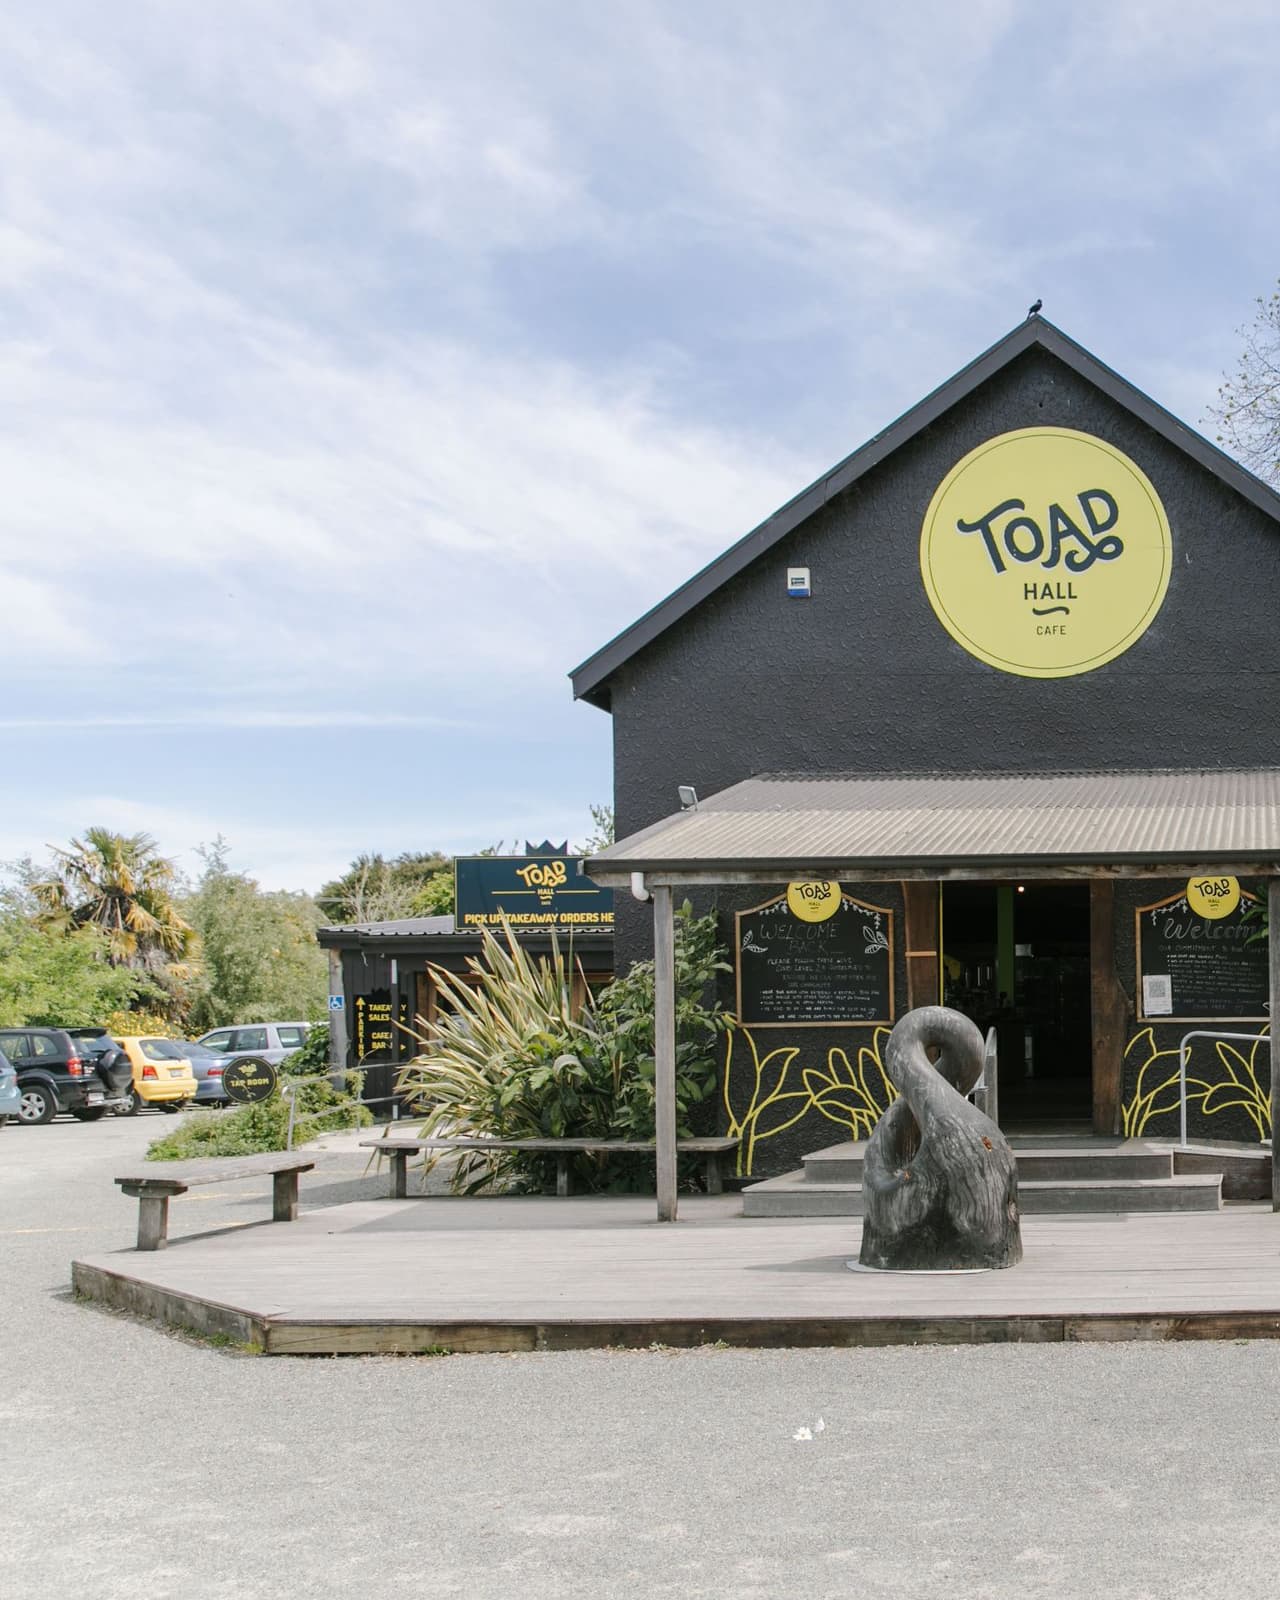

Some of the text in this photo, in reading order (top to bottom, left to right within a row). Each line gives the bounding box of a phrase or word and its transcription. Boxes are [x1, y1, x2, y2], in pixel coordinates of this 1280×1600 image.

[957, 488, 1124, 574] TOAD
[1024, 582, 1078, 600] HALL
[1036, 625, 1067, 636] CAFE
[516, 861, 567, 888] TOAD
[537, 888, 555, 896] HALL
[795, 881, 832, 900] TOAD
[1194, 878, 1231, 898] TOAD
[464, 913, 488, 924] PICK
[489, 913, 503, 924] UP
[505, 912, 559, 924] TAKEAWAY
[560, 912, 599, 923] ORDERS
[760, 923, 840, 940] WELCOME
[1164, 917, 1257, 940] Welcom
[368, 1004, 407, 1012] TAKEAY
[368, 1013, 390, 1021] SALES
[371, 1031, 391, 1040] CAFE
[371, 1041, 386, 1049] BAR
[230, 1078, 269, 1088] TAP ROOM
